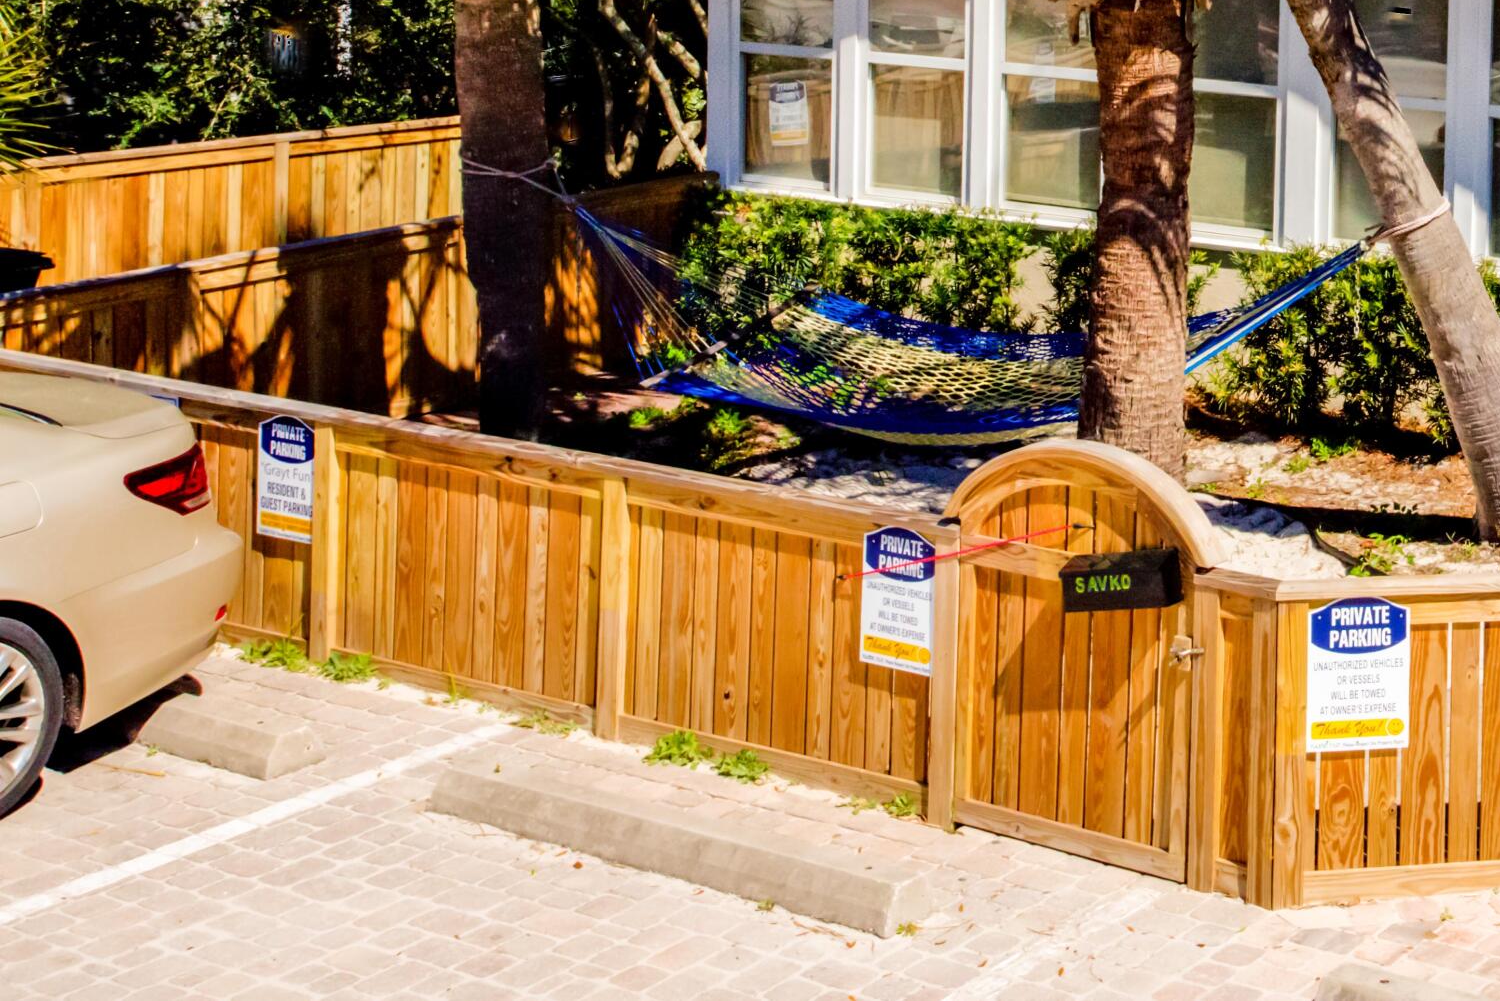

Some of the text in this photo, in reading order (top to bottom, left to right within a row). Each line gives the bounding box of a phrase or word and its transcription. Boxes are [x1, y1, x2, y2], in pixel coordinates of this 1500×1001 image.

[272, 423, 305, 442] PRIVATE
[270, 440, 306, 460] PARKING
[267, 482, 306, 500] RESIDENT &
[261, 496, 313, 517] GUEST PARKING
[880, 534, 924, 558] PRIVATE
[878, 554, 924, 579] PARKING
[866, 581, 905, 596] UNAUTHORIZED
[1075, 573, 1131, 594] SAVKO
[883, 597, 890, 606] OR
[878, 610, 918, 626] WILL BE TOWED
[1331, 605, 1390, 627] PRIVATE
[870, 622, 877, 630] AT
[901, 628, 926, 642] EXPENSE
[1329, 627, 1392, 649] PARKING
[866, 636, 892, 652] Thank
[1313, 658, 1404, 672] UNAUTHORIZED VEHICLES
[1336, 674, 1381, 685] OR VESSELS
[1330, 688, 1387, 701] WILL BE TOWED
[1319, 702, 1397, 716] AT OWNER'S EXPENSE
[1316, 720, 1383, 737] Thank You!
